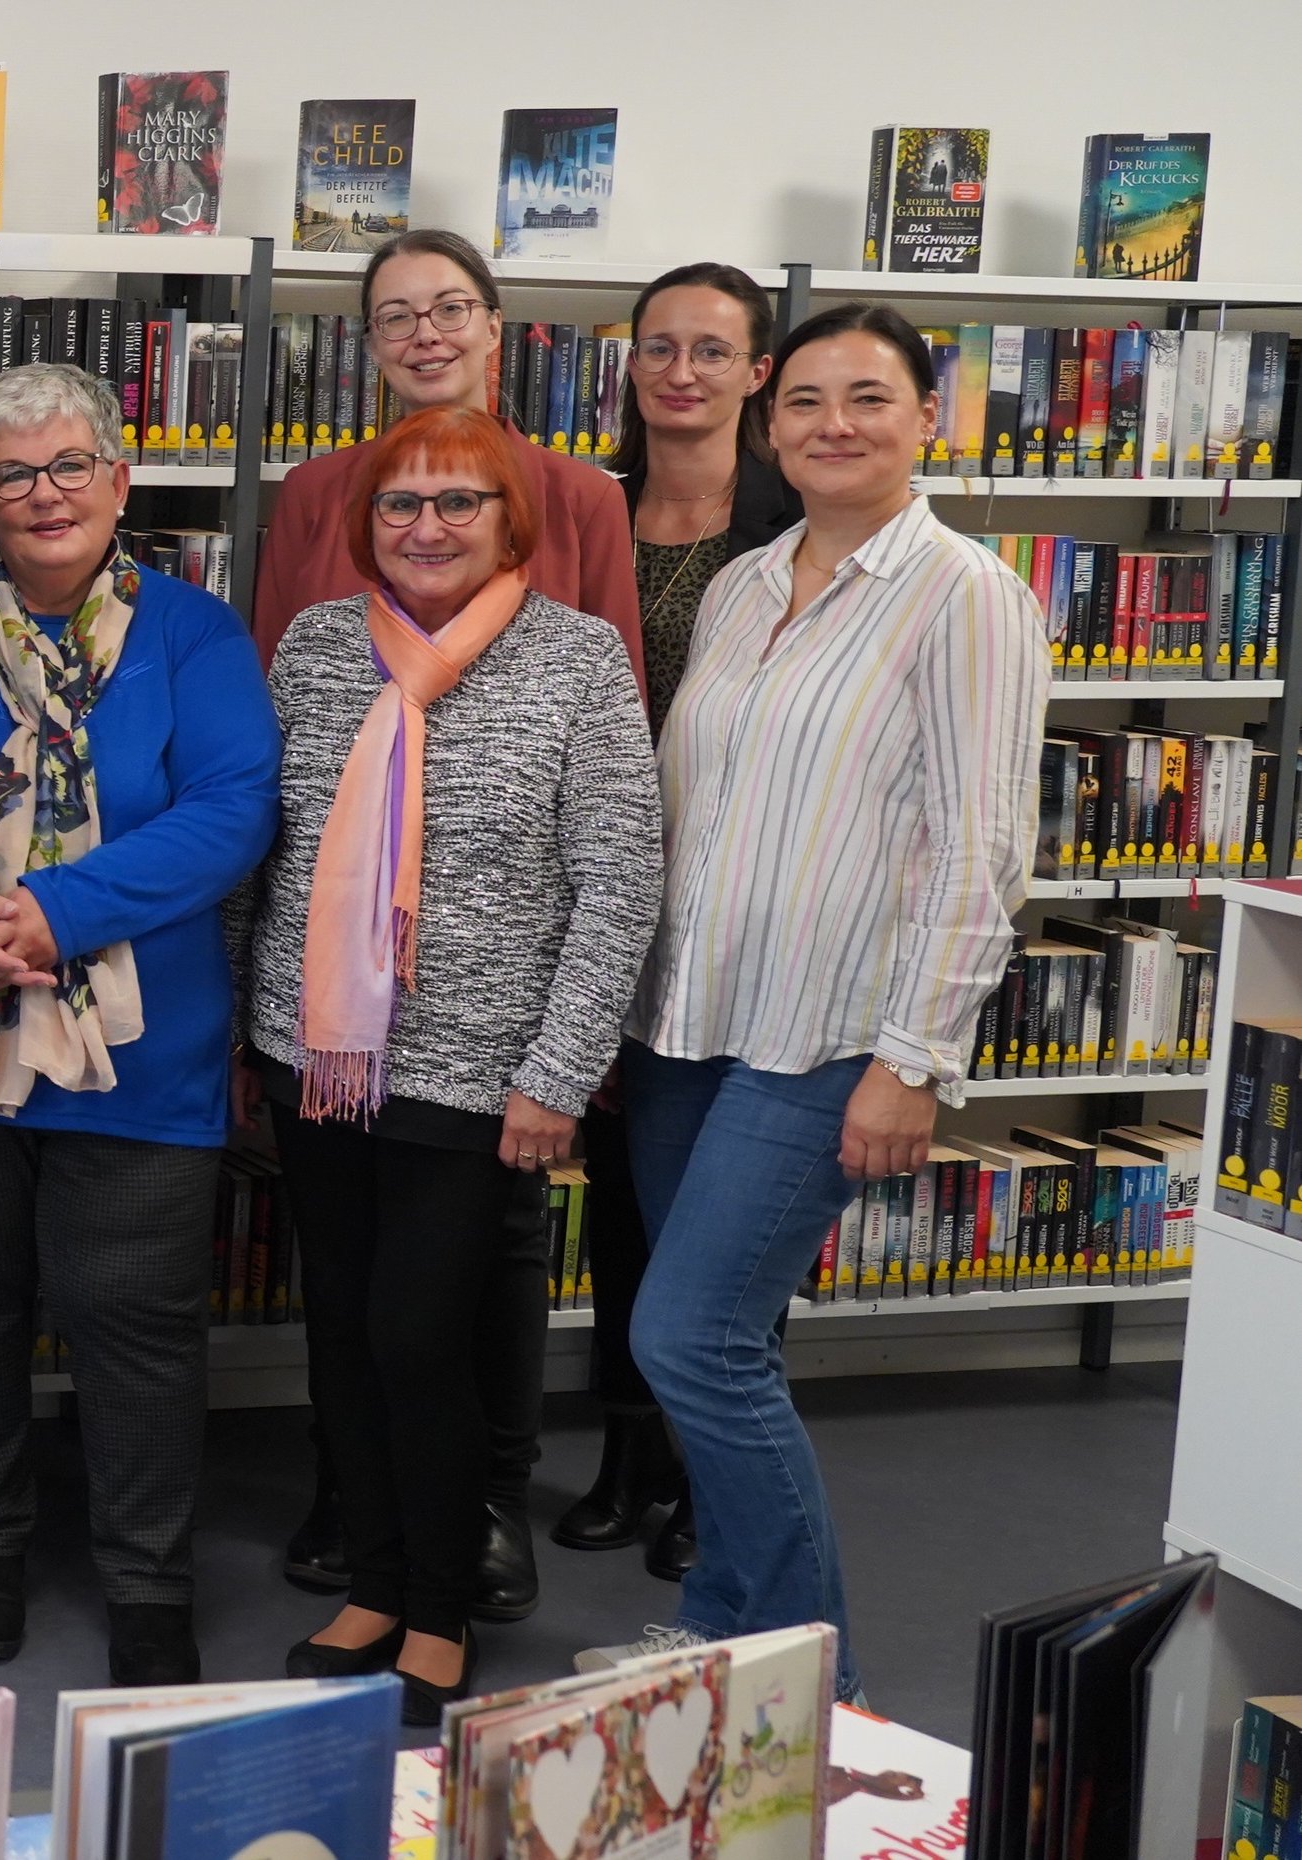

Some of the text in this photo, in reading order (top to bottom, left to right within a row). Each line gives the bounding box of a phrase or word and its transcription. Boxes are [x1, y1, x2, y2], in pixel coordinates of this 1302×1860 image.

[145, 110, 201, 127] MARY
[333, 125, 387, 144] LEE
[127, 128, 216, 144] HIGGINS
[544, 122, 616, 172] KALTE
[138, 146, 202, 162] CLARK
[313, 146, 404, 166] CHILD
[1160, 160, 1181, 169] DES
[326, 182, 388, 191] DER LETZTE
[508, 152, 613, 201] MACHT
[336, 194, 375, 203] BEFEHL
[896, 206, 981, 218] GALBRAITH
[894, 235, 979, 245] TIEFSCHWARZE
[908, 223, 932, 233] DAS
[912, 246, 967, 263] HERZ
[67, 309, 76, 357] SELFIES
[98, 308, 111, 374] OPFER 2117
[124, 322, 135, 374] NATRIUM
[134, 321, 143, 374] CHLORID
[301, 332, 309, 360] NICHT
[348, 337, 356, 371] SCHULD
[1264, 345, 1273, 377] STRAFE
[1270, 350, 1279, 390] VERDIENT
[580, 348, 593, 402] TODESKÄFIG
[1027, 359, 1039, 401] ELIZABETH
[1058, 359, 1071, 401] ELIZABETH
[291, 386, 300, 426] HARLAN
[298, 391, 306, 421] COBEN
[316, 388, 324, 424] HARLAN
[1190, 403, 1200, 435] ELIZABETH
[1223, 403, 1233, 436] ELIZABETH
[1257, 403, 1267, 436] ELIZABETH
[1266, 408, 1274, 433] GEORGE
[1156, 412, 1164, 444] ELIZABETH
[1073, 551, 1094, 593] WESTWALL
[1098, 581, 1109, 625] TURM
[1141, 569, 1151, 610] TRAUMA
[1243, 561, 1255, 619] GRISHAM
[1220, 593, 1232, 635] GRISHAM
[1167, 755, 1175, 778] 42
[1086, 802, 1096, 831] HERZ
[1189, 776, 1200, 842] KONKLAVE
[1255, 771, 1268, 842] TERRY HAYES FACELESS
[1074, 887, 1083, 897] H
[1237, 1073, 1254, 1120] FALLE
[1273, 1084, 1290, 1129] MOOR
[1235, 1127, 1243, 1147] WOLF
[1057, 1179, 1069, 1212] SØG
[1167, 1172, 1182, 1209] DUNKEL
[1183, 1172, 1200, 1207] INSEL
[917, 1215, 929, 1265] JACOBSEN
[940, 1215, 954, 1262] JACOBSEN
[962, 1213, 975, 1262] JACOBSEN
